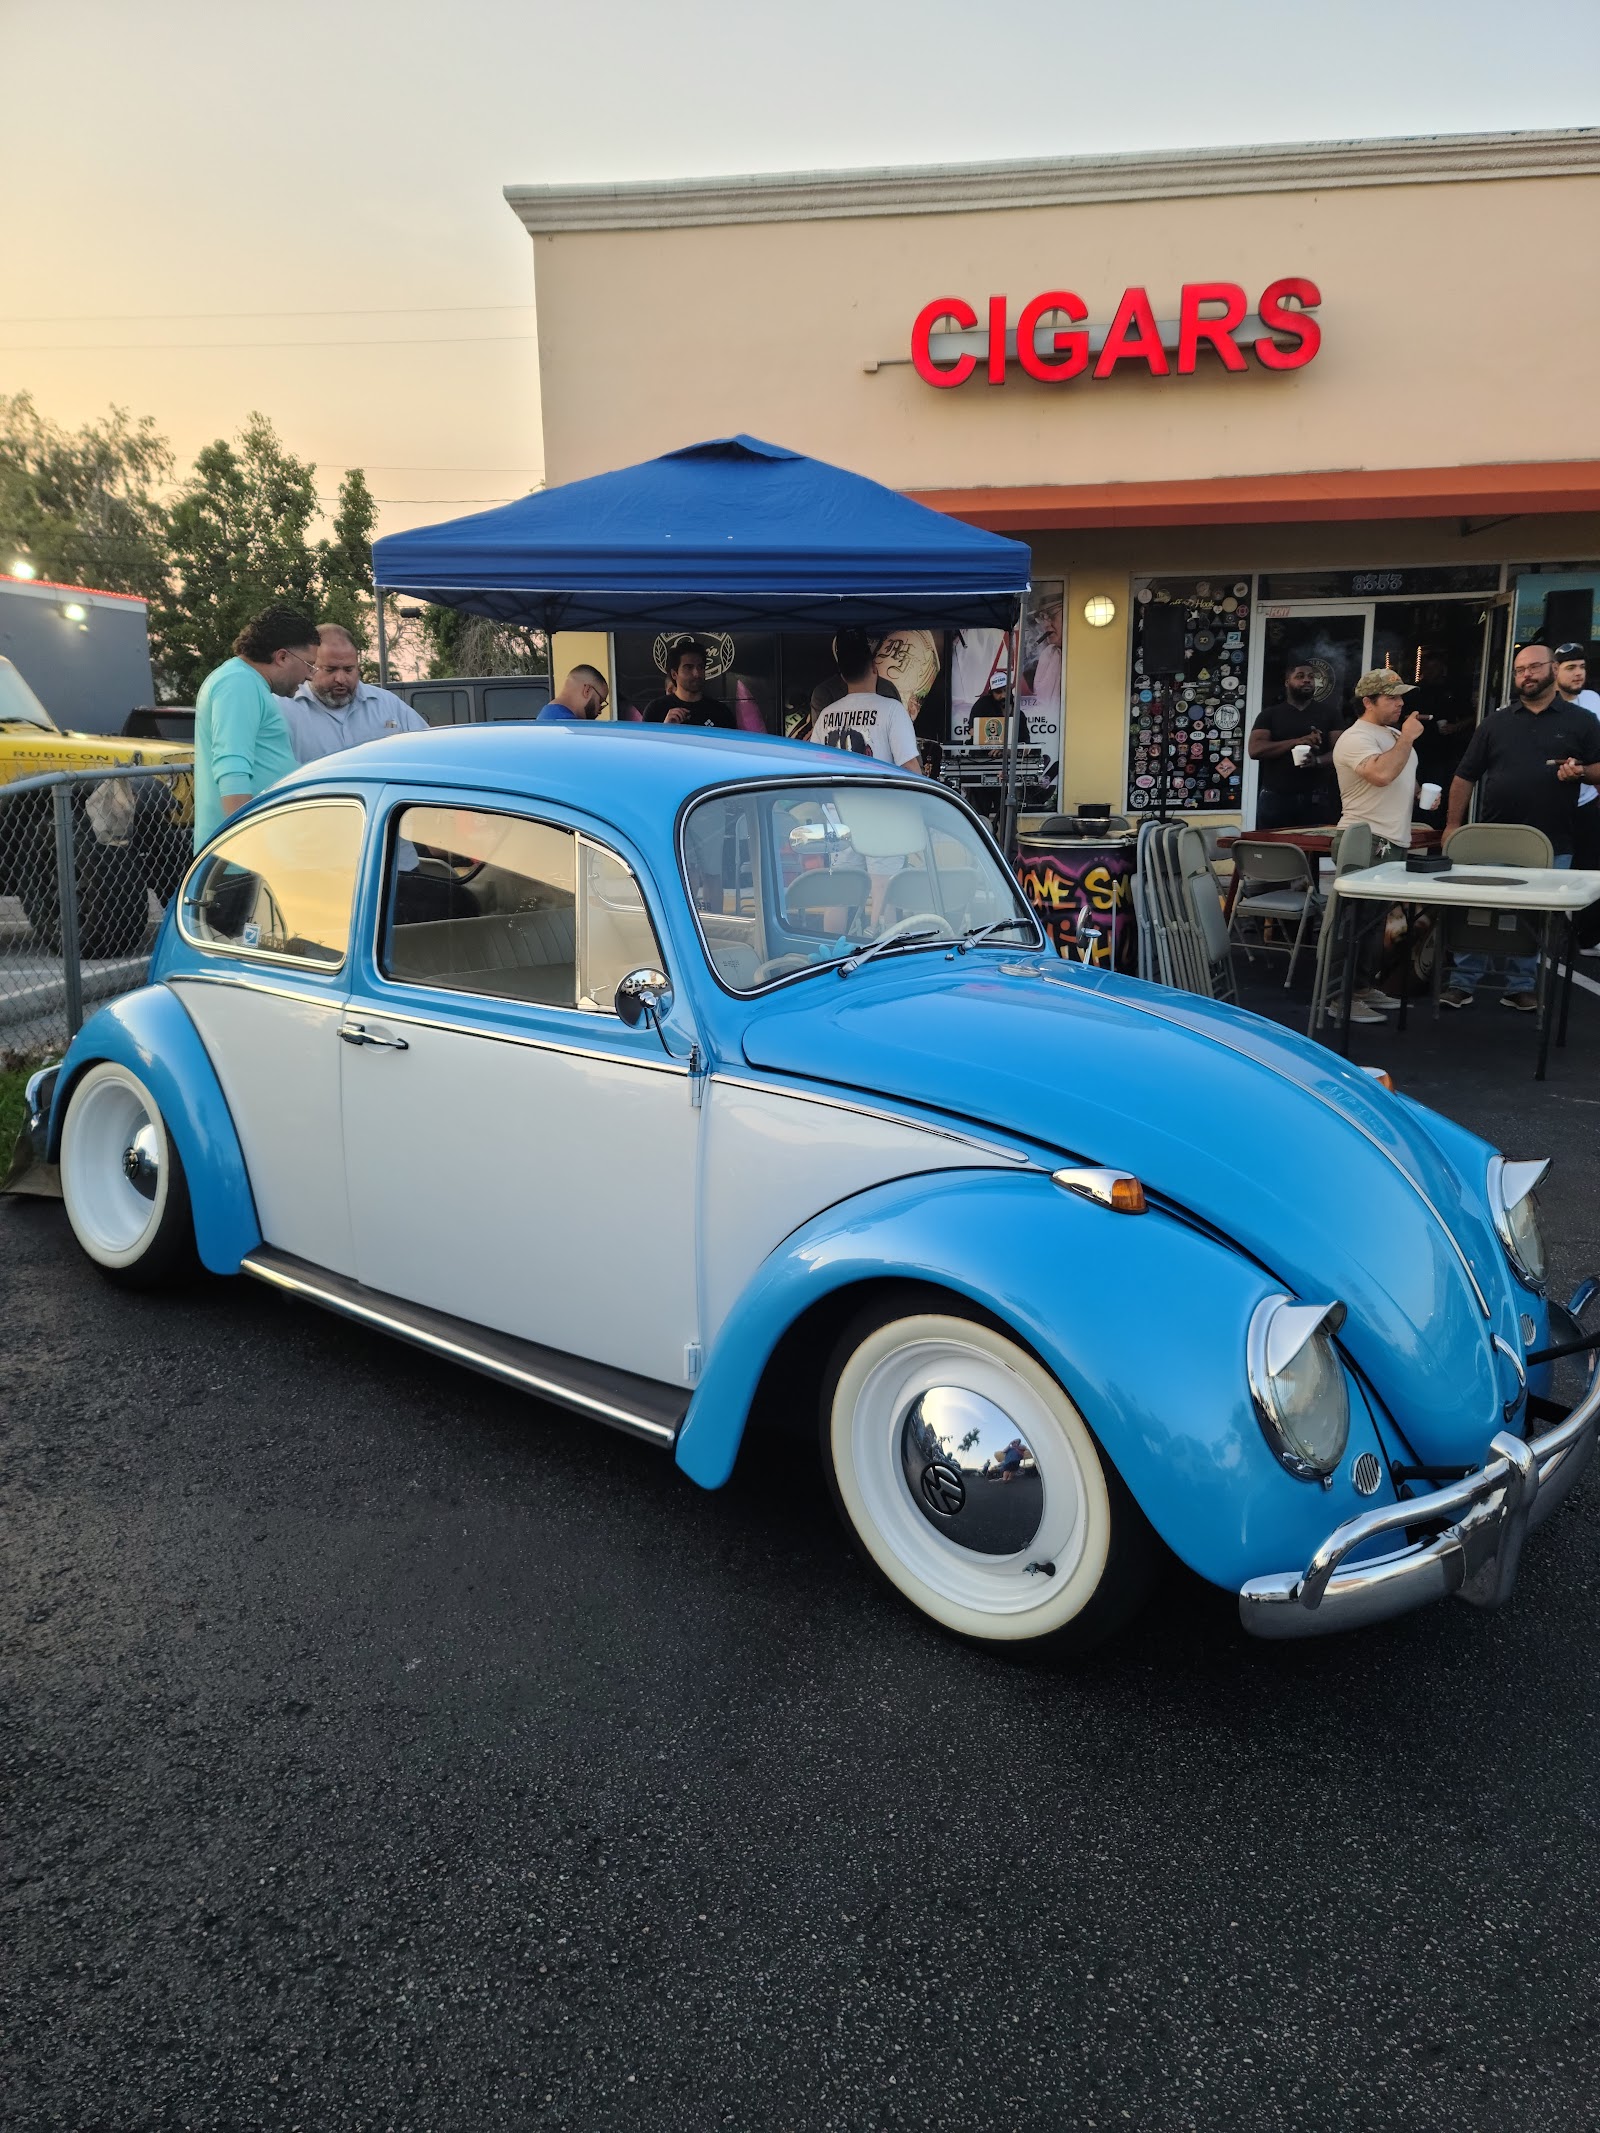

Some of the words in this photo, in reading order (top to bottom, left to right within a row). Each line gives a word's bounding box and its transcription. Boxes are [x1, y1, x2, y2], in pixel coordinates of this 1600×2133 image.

[911, 276, 1322, 389] CIGARS
[823, 710, 878, 730] PANTHERS
[13, 750, 109, 761] RUBICON
